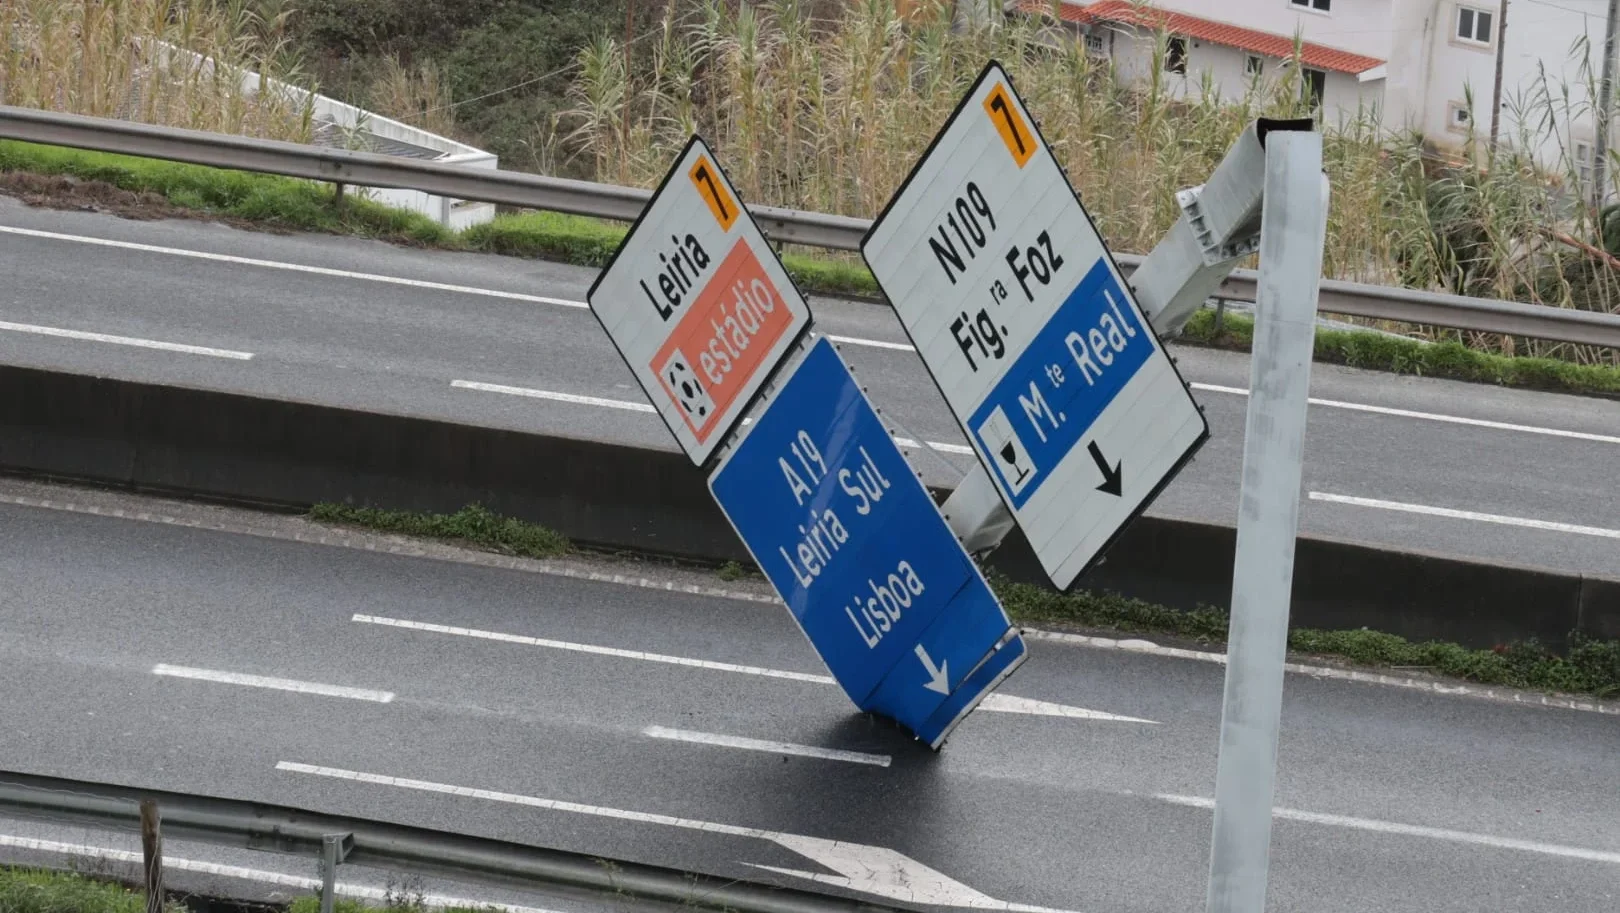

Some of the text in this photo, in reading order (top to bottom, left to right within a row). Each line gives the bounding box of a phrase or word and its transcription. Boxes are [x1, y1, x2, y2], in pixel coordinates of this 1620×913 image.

[991, 94, 1026, 155] 7
[696, 166, 728, 220] 7
[928, 181, 997, 285] N109
[640, 233, 711, 322] Leiria
[1005, 230, 1064, 301] Foz
[699, 276, 775, 385] estádio
[1064, 290, 1136, 385] Real
[778, 430, 828, 506] A19
[780, 446, 891, 588] Leiria Sul
[845, 560, 925, 649] Lisboa
